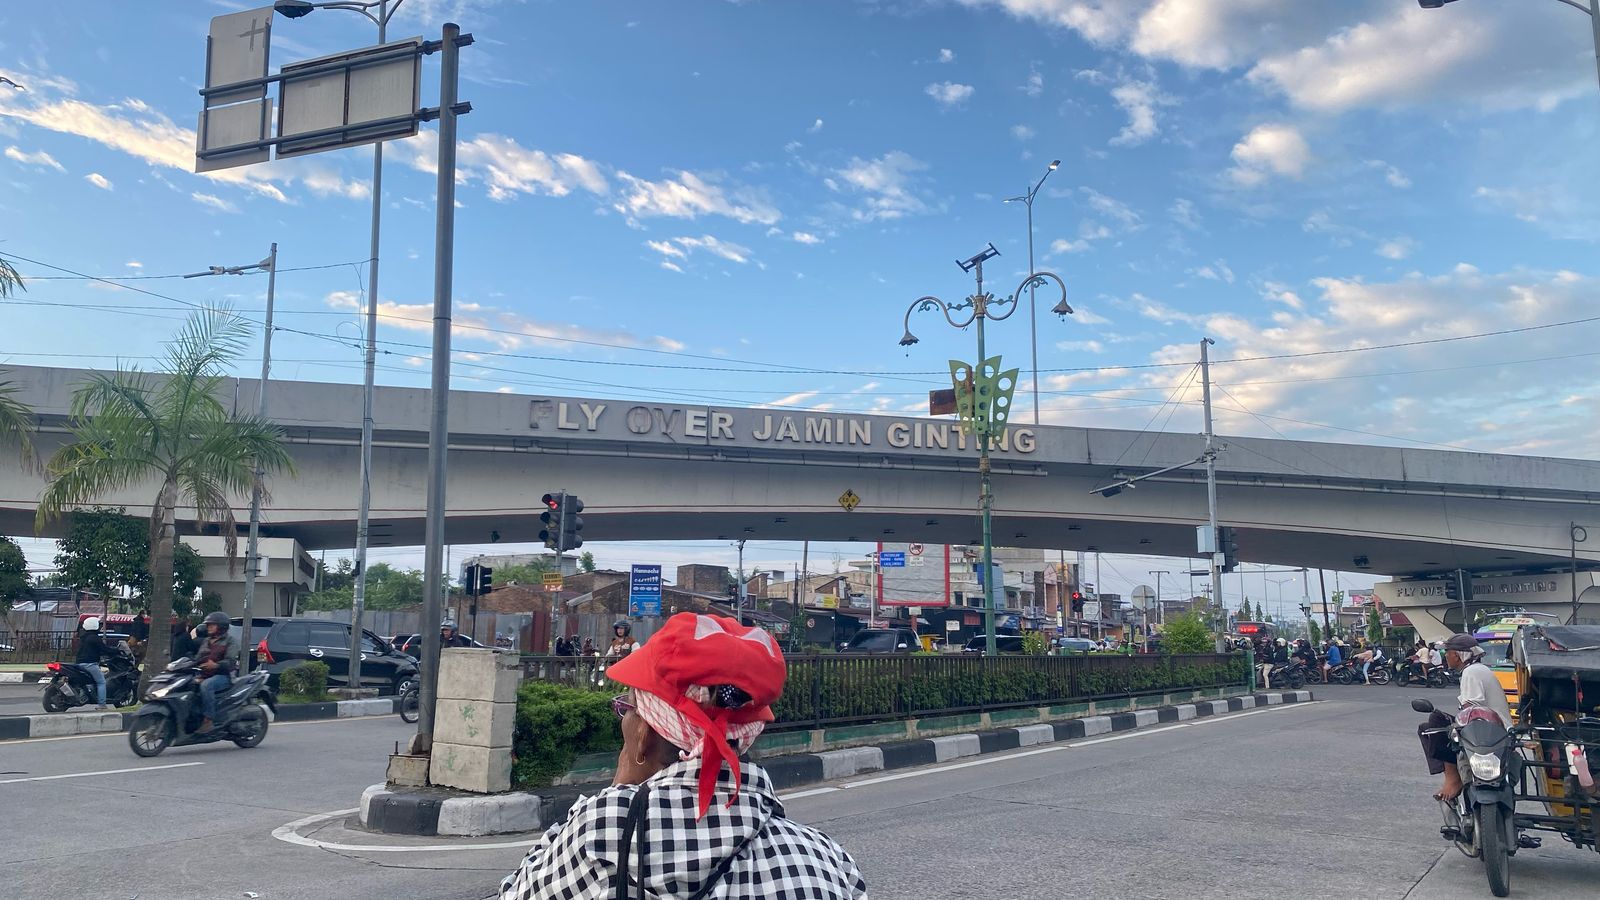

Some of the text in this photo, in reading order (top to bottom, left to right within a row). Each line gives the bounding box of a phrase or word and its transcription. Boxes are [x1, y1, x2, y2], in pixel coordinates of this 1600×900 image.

[529, 399, 1037, 454] FLY OVER JAMIN GINTNG
[1397, 587, 1416, 597] FLY
